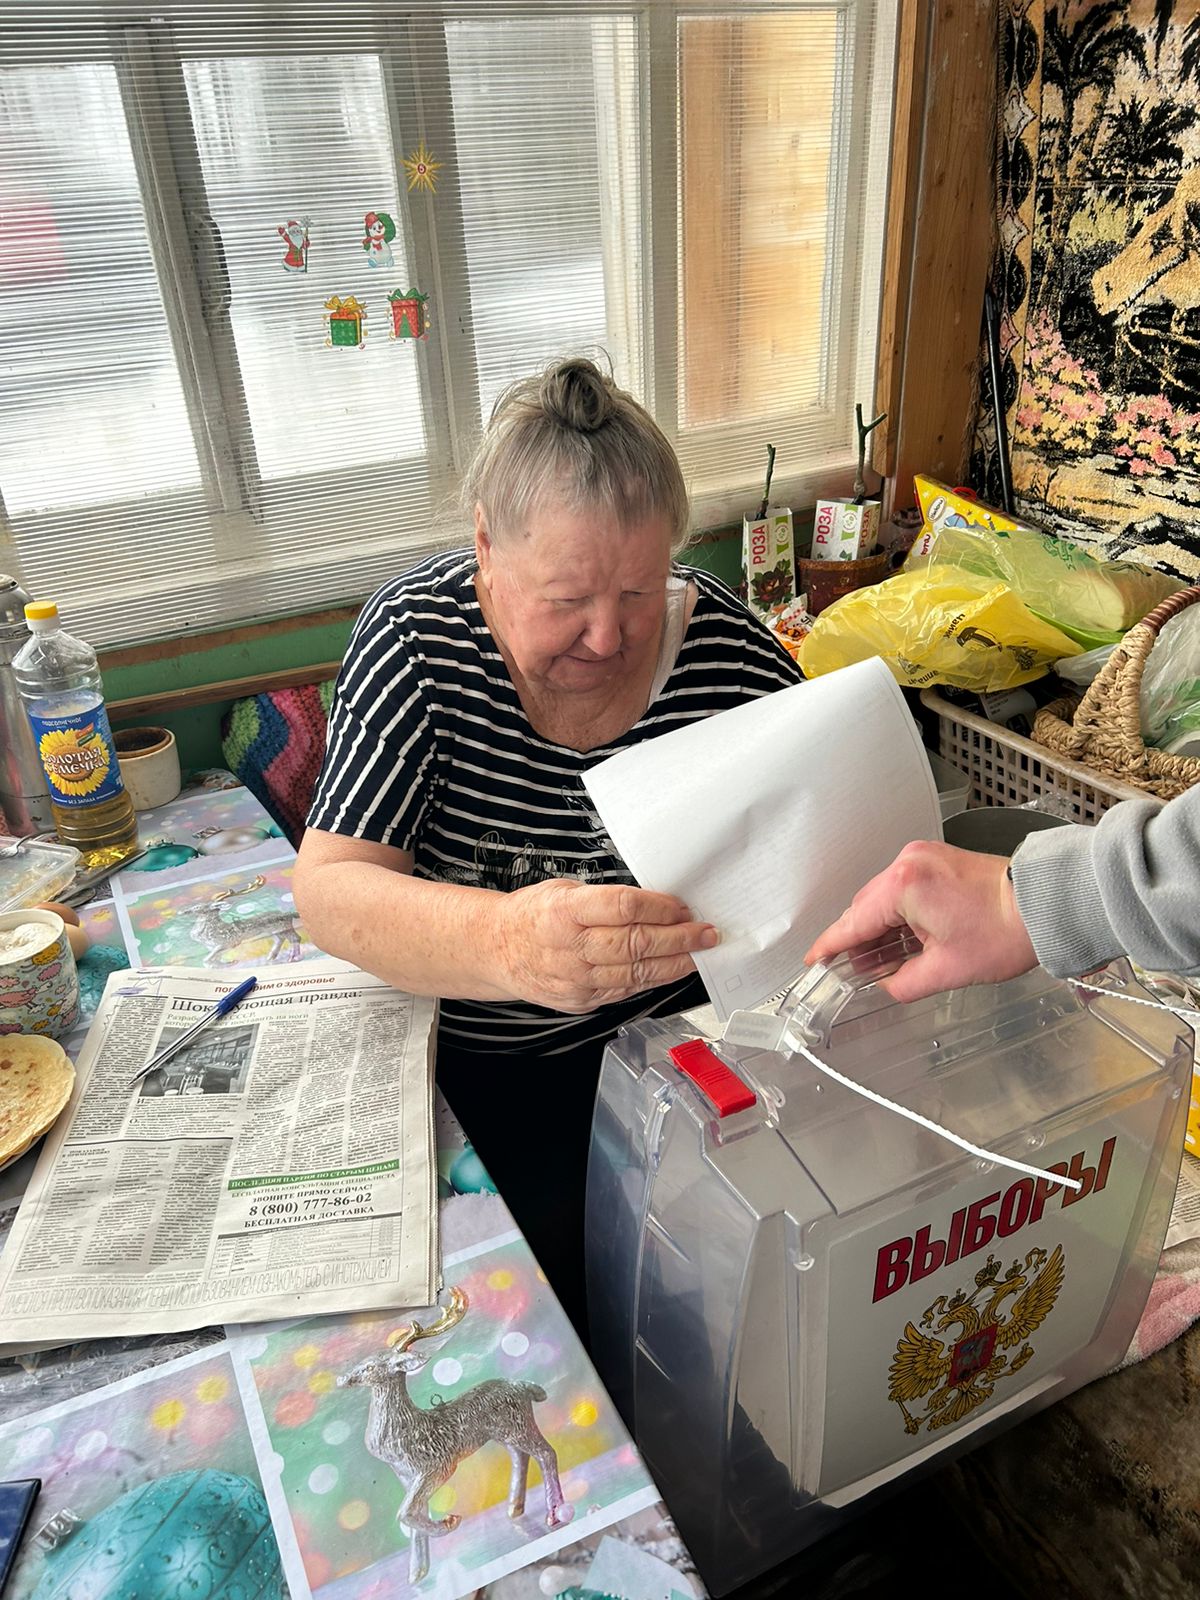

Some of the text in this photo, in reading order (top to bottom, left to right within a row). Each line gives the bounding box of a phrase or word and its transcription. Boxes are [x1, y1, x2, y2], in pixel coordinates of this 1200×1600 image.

[816, 506, 833, 545] РОЗА
[860, 510, 870, 548] РОЗА
[752, 525, 766, 565] РОЗА
[215, 984, 275, 993] погрим
[284, 976, 335, 987] здоровье
[171, 990, 363, 1014] Шокующая правда:
[231, 1178, 282, 1188] ПОСЛЕДНЯЯ
[283, 1174, 316, 1182] ПАРТИЯ
[330, 1168, 365, 1178] СТАРЫМ
[231, 1173, 395, 1198] БЕСПЛАТНАЯ КОНСУЛЬТАЦИЯ СПЕЦИАЛИСТА
[249, 1192, 372, 1217] 8 (800) 777-86-02
[253, 1184, 373, 1203] ЗВОНИТЕ ПРЯМО СЕЙЧАС!
[244, 1206, 374, 1228] БЕСПЛАТНАЯ ДОСТАВКА
[872, 1135, 1118, 1304] ВЫБОРЫ
[256, 1265, 321, 1294] ОЗНАКОМЬТЕСЬ
[323, 1264, 333, 1287] С
[332, 1258, 392, 1284] ИНСТРУКЦИЕЙ
